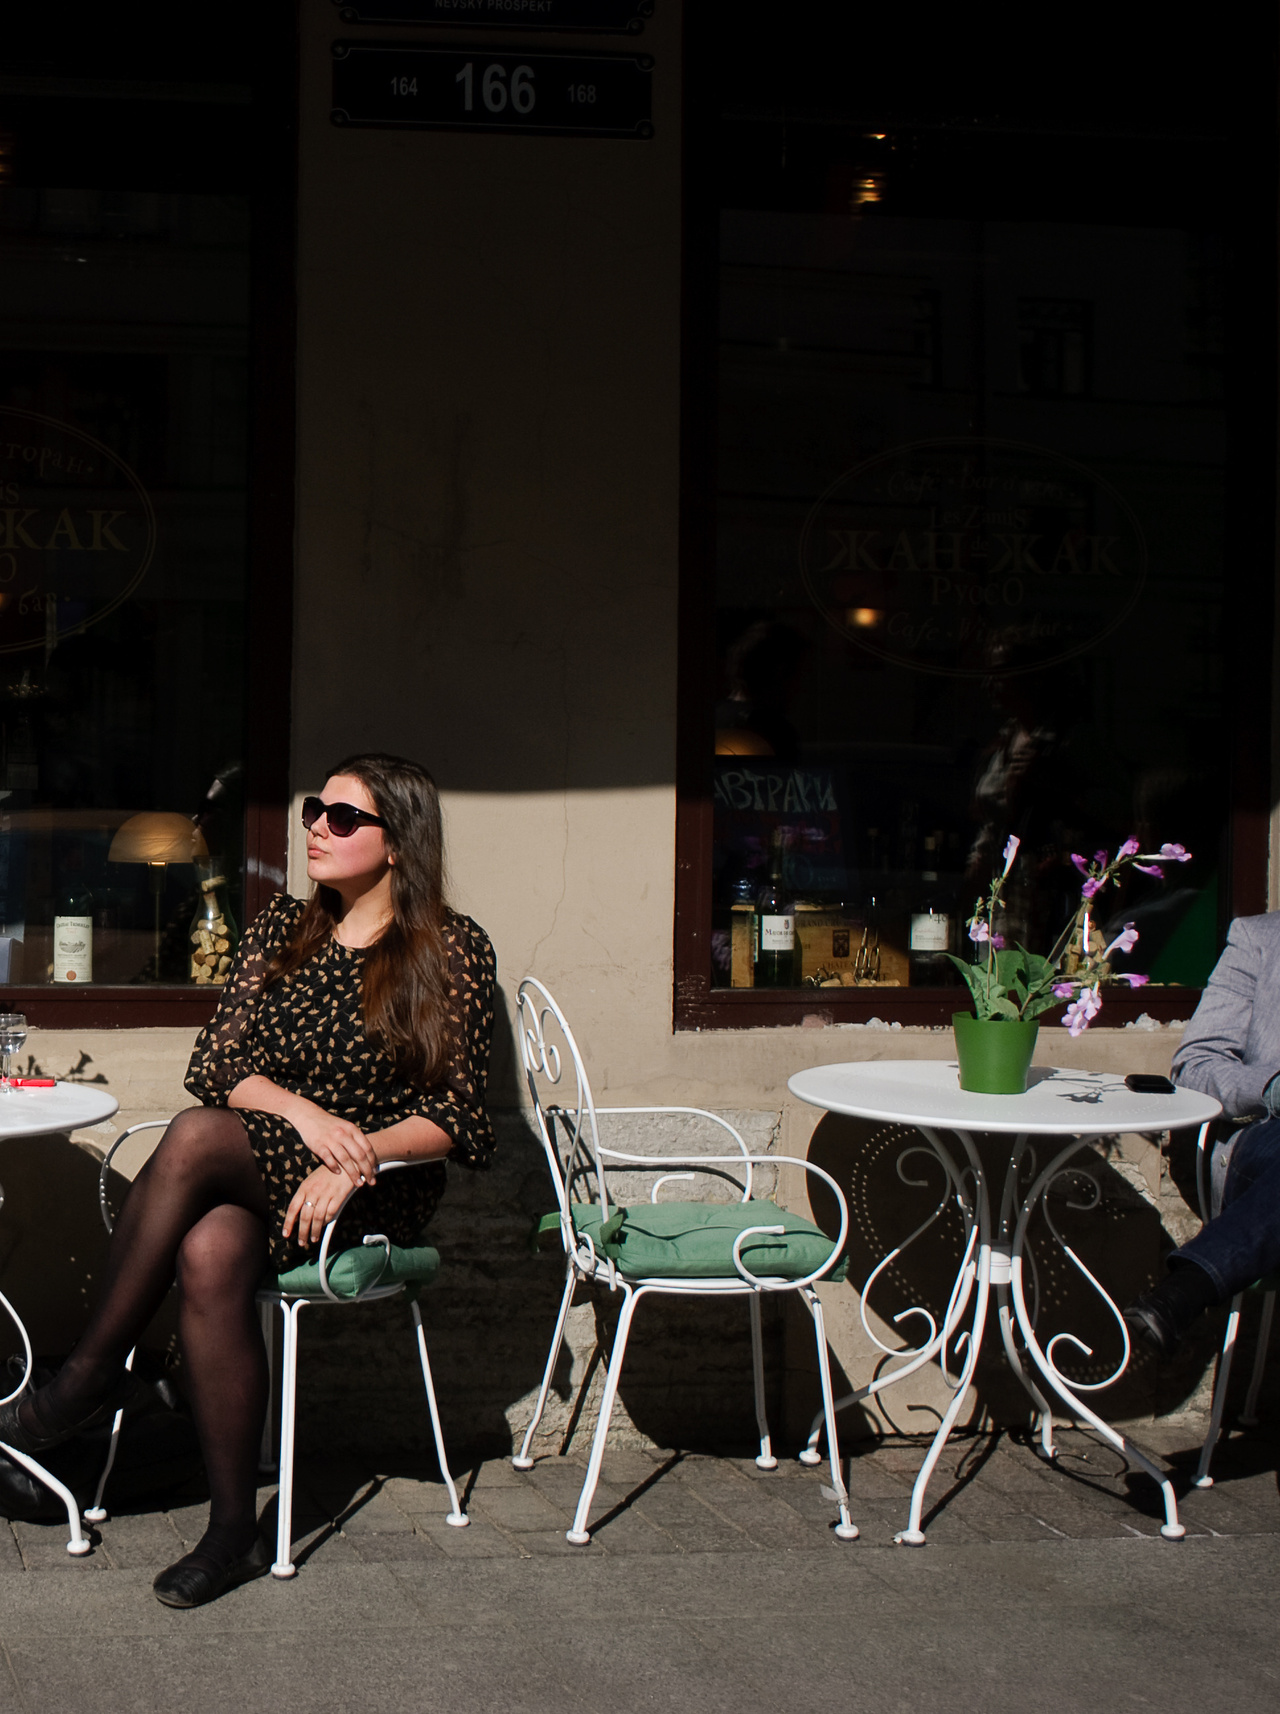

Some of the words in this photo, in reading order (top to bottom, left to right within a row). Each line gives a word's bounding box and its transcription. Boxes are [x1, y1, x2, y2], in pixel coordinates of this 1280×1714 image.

[433, 0, 483, 9] NEVSKY
[486, 0, 553, 12] PROSPEKT
[390, 76, 418, 97] 164
[455, 61, 536, 114] 166
[567, 84, 597, 104] 168
